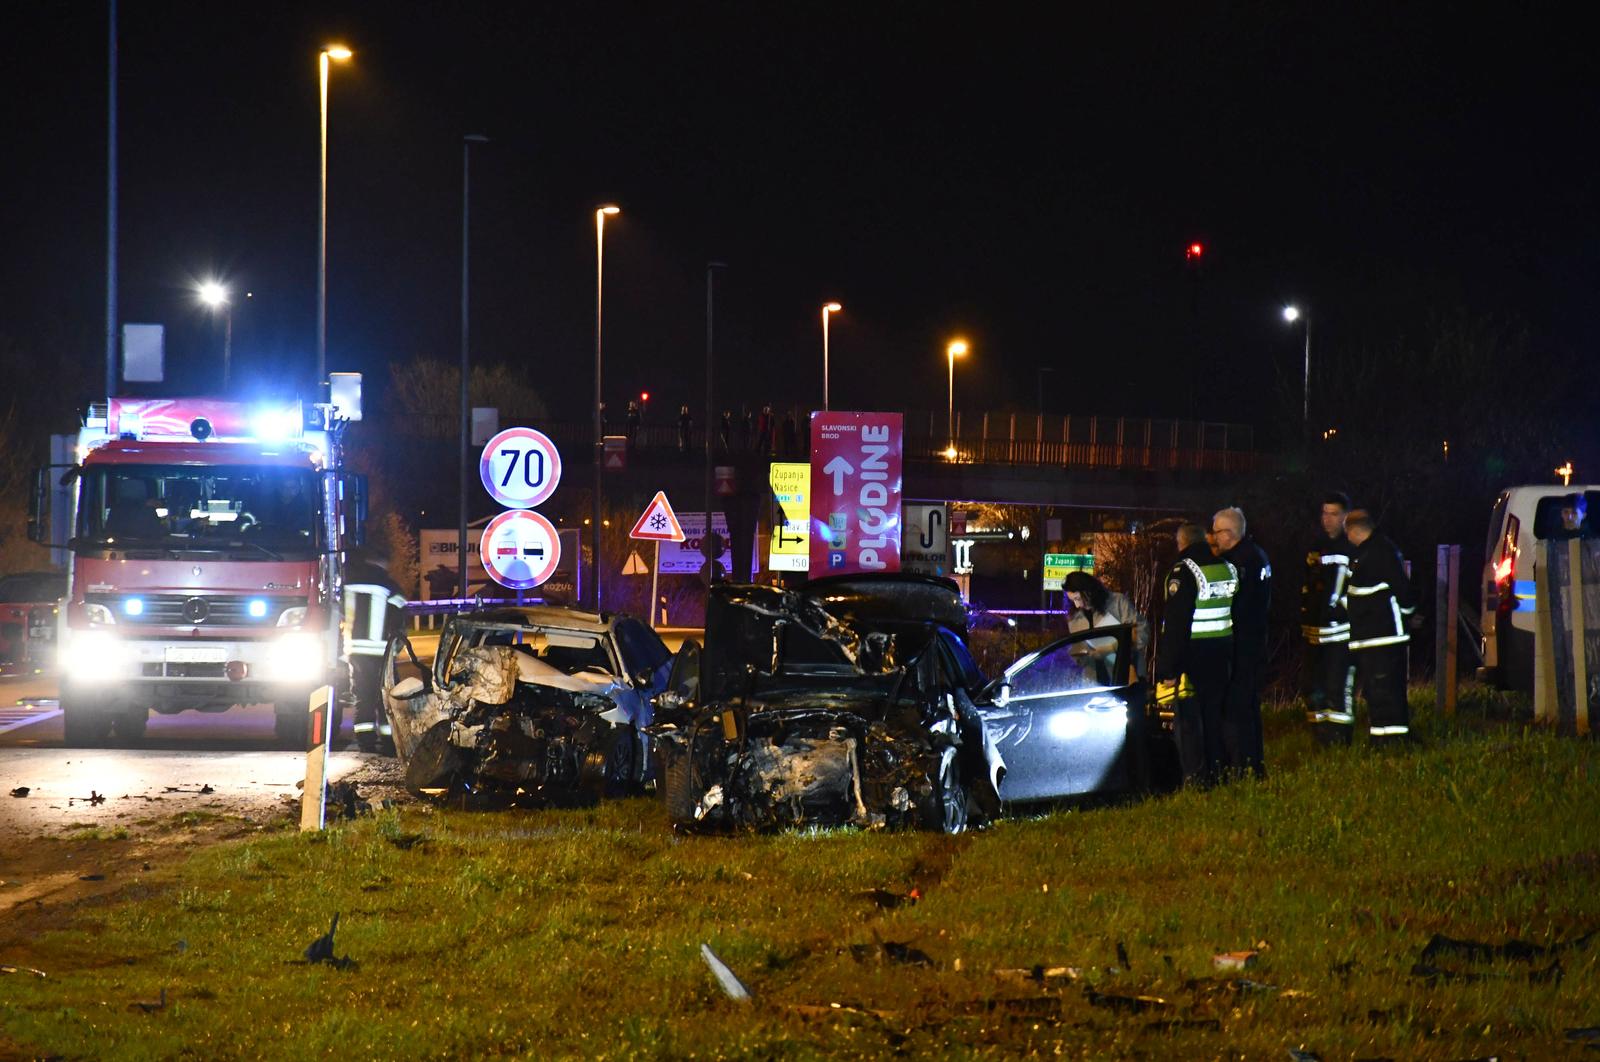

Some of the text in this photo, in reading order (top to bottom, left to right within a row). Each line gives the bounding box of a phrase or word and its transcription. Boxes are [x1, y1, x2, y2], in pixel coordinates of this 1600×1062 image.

[821, 424, 857, 432] SLAVONSKI
[500, 449, 545, 488] 70
[859, 424, 890, 570] PLODINE
[791, 558, 807, 568] 150
